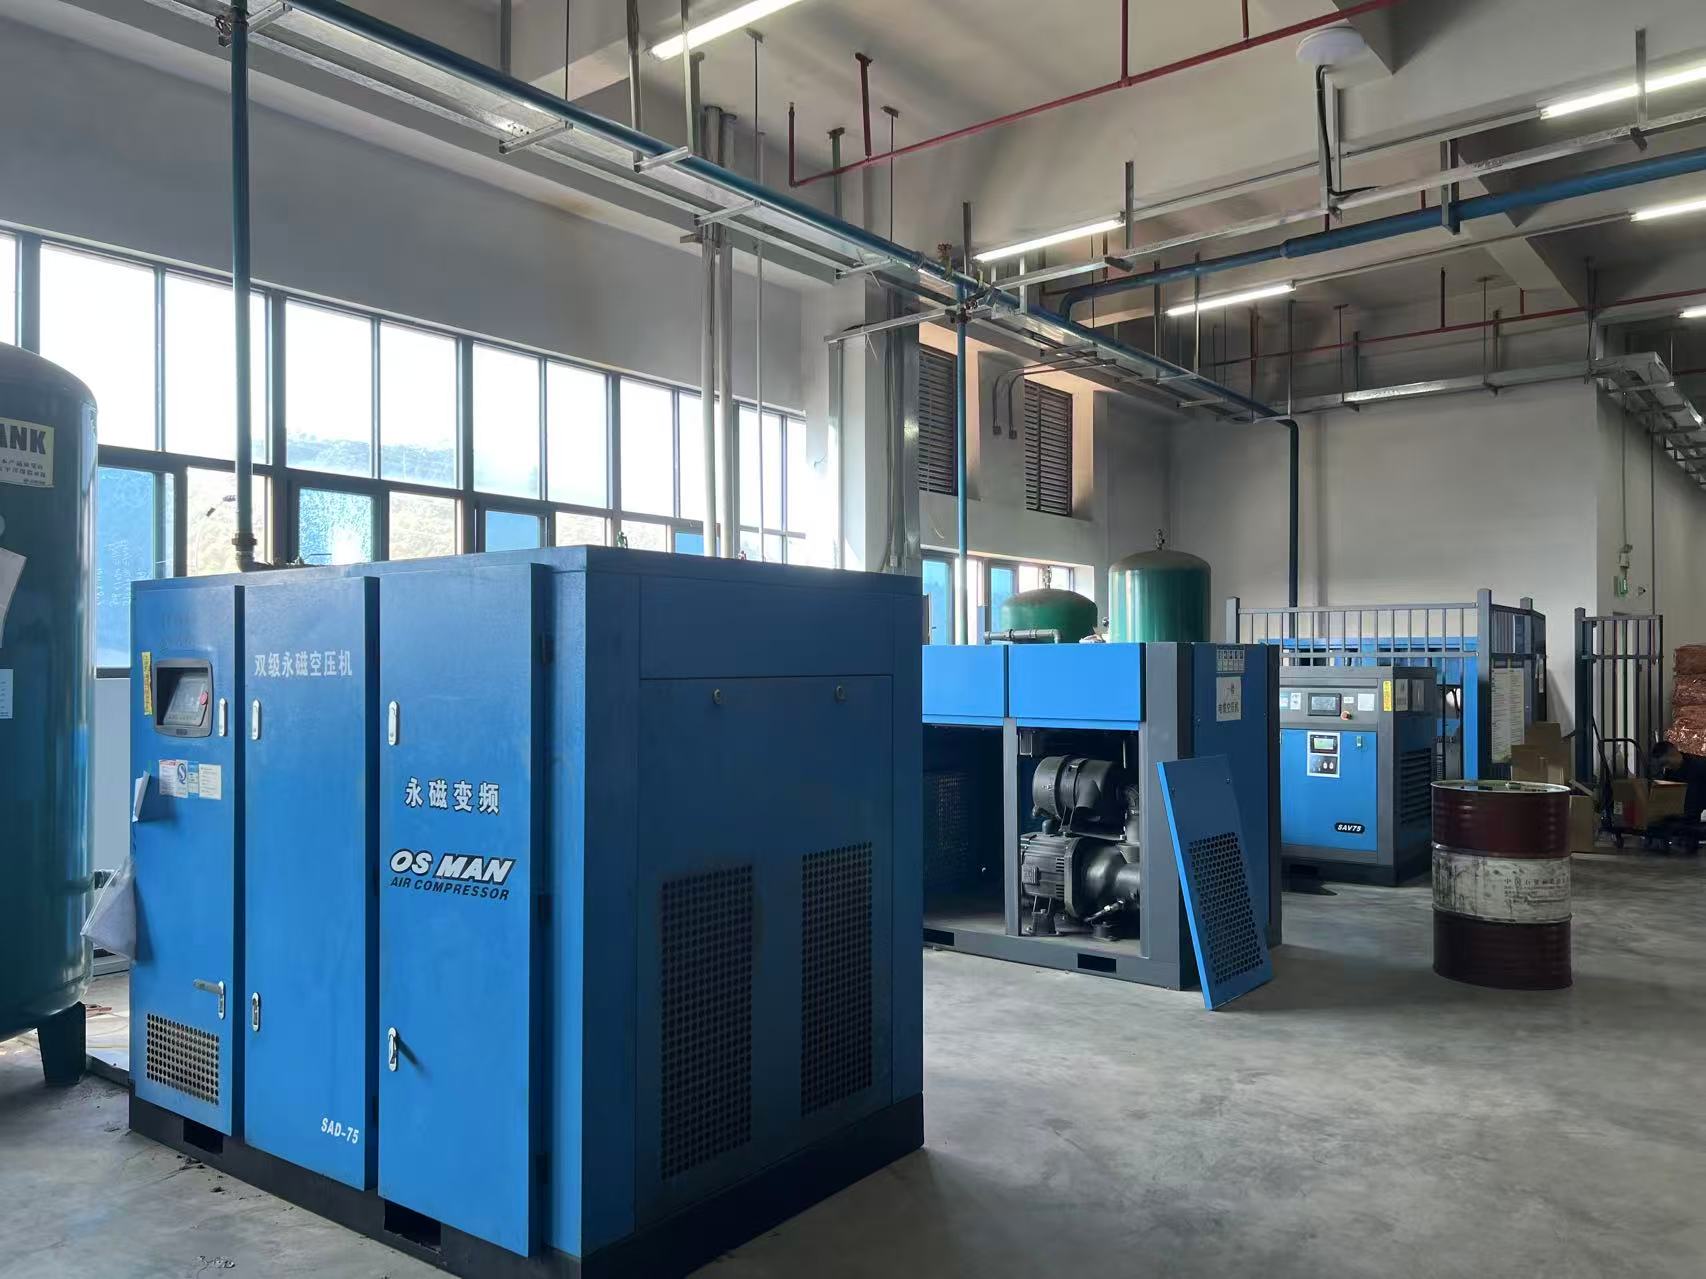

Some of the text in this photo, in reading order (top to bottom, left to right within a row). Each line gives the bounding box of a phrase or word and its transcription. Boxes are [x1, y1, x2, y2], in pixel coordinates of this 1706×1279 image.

[254, 649, 352, 678] 双级永磁空压机
[405, 776, 500, 815] 永磁变频
[1337, 824, 1362, 832] SAV75
[433, 853, 516, 885] MAN
[390, 877, 509, 901] AIR COMPRESSOR
[321, 1117, 359, 1144] SAD-75
